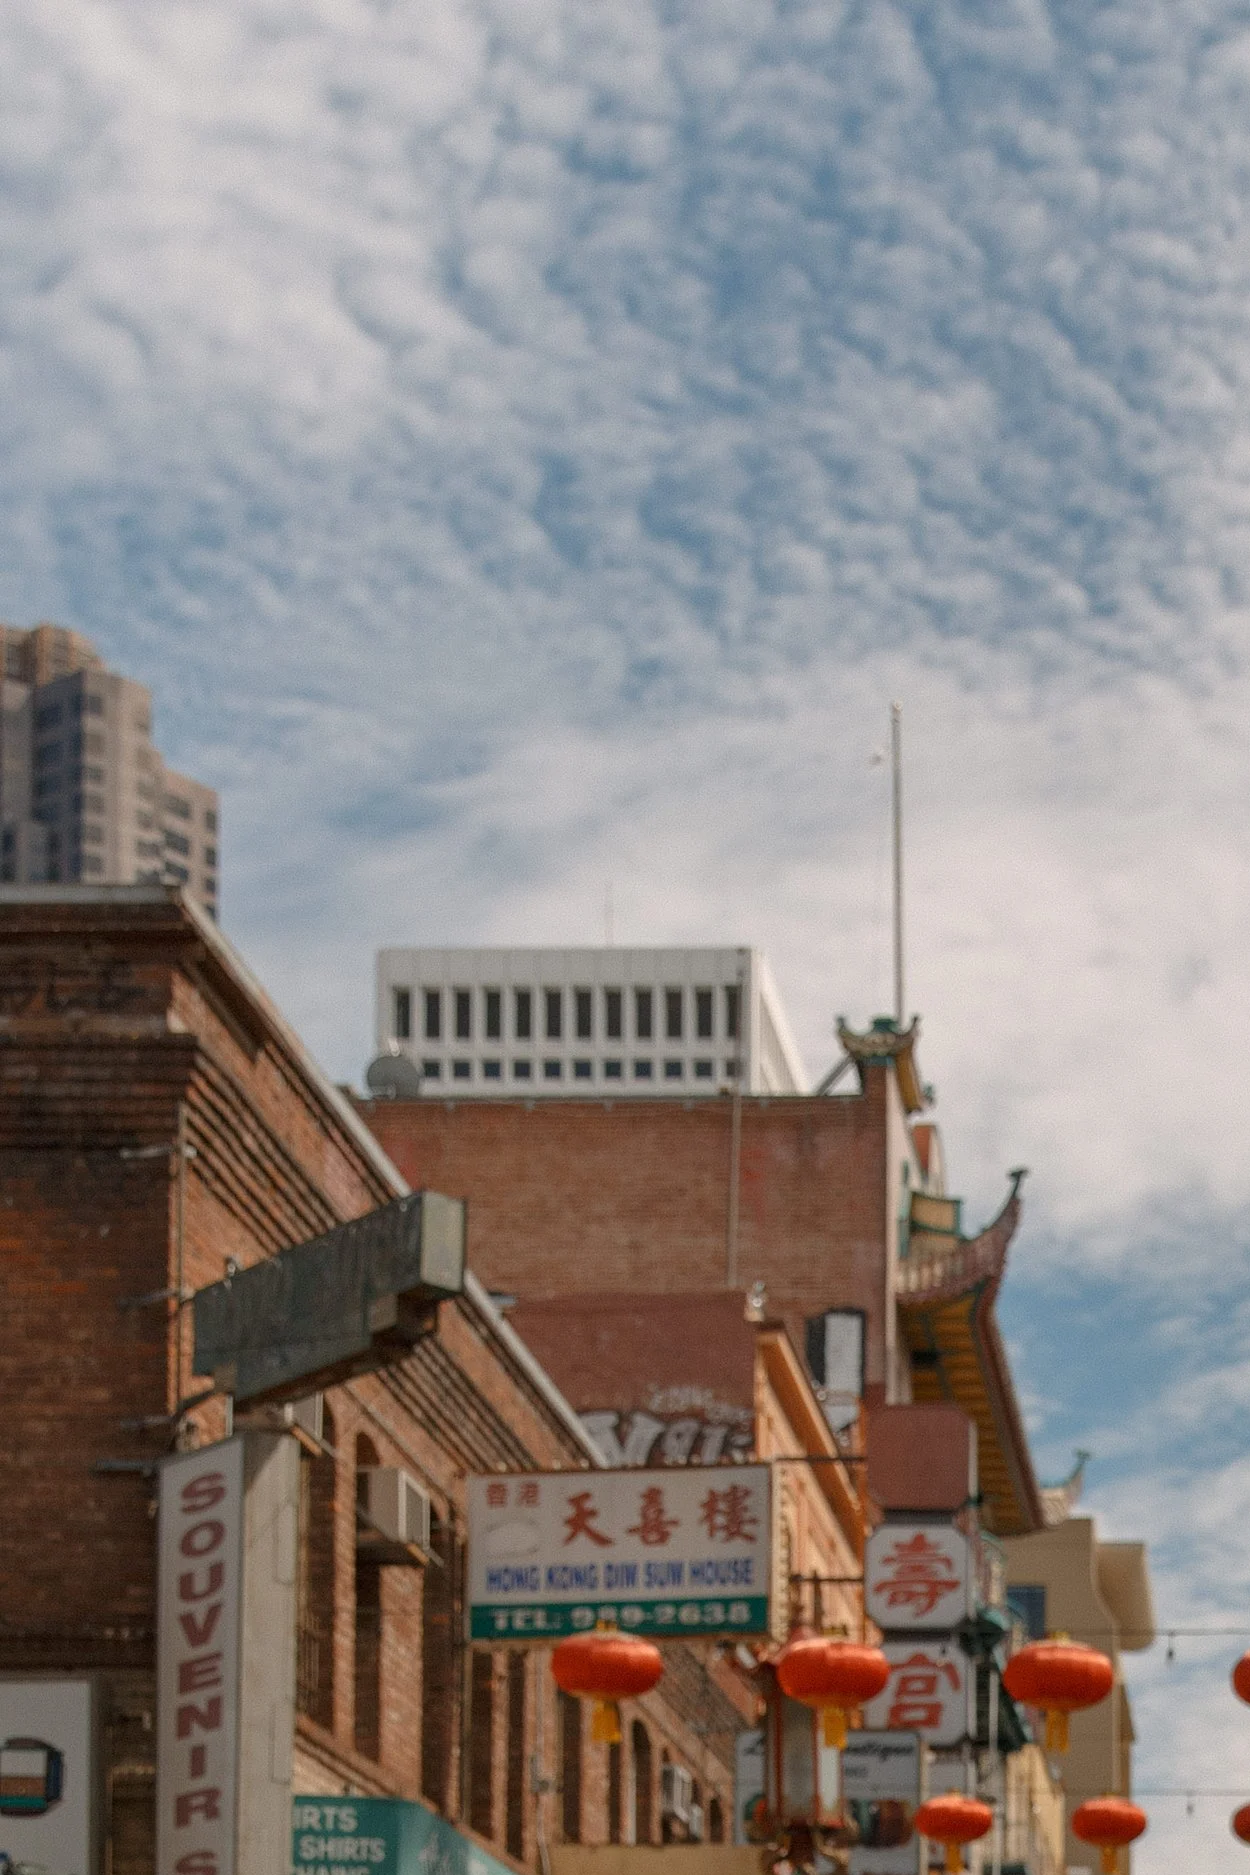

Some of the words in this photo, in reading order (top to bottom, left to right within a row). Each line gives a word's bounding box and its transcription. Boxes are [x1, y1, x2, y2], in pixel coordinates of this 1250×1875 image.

[486, 1564, 541, 1594] HONG
[545, 1561, 598, 1591] KONG
[603, 1560, 638, 1590] DIM
[644, 1559, 684, 1588] SUM
[689, 1556, 755, 1586] HOUSE
[174, 1472, 226, 1829] SOUVENIR
[300, 1834, 387, 1863] SHIRTS
